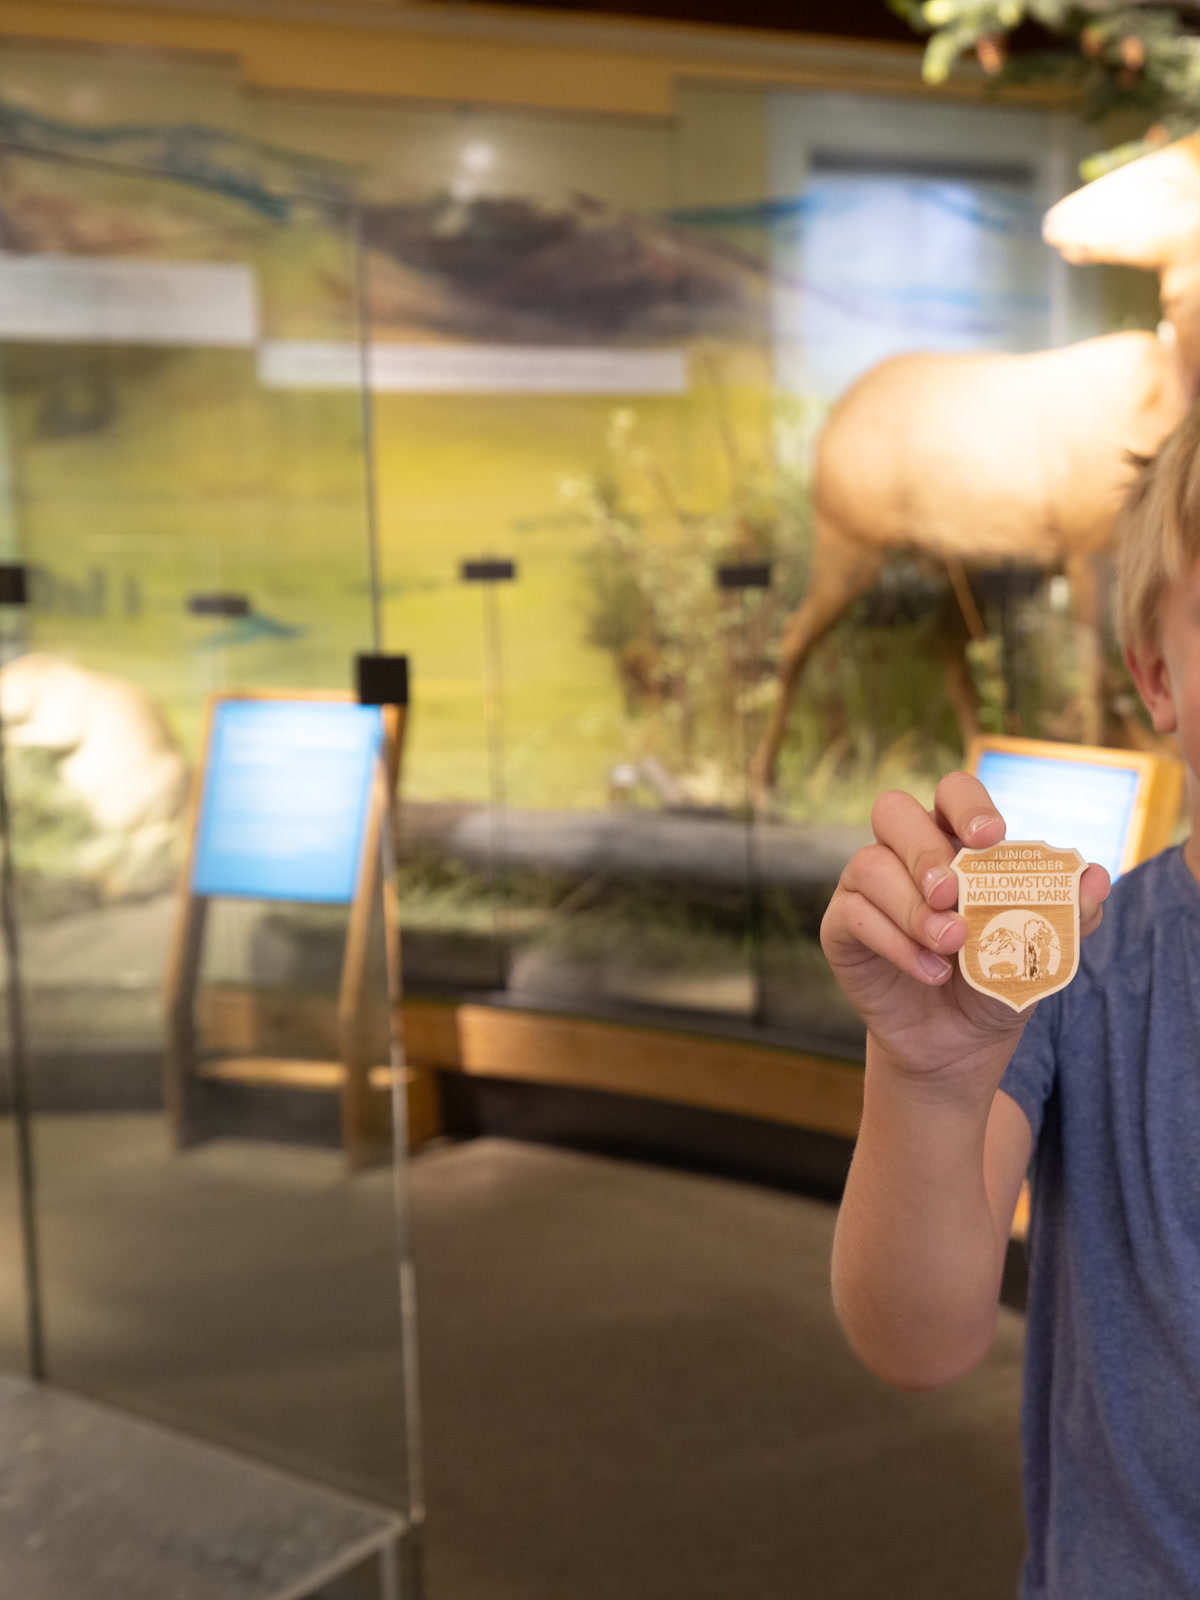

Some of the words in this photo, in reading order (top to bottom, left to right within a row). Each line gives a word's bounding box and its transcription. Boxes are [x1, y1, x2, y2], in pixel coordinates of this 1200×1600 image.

[993, 850, 1041, 860] JUNIOR
[971, 861, 1004, 871] PARK
[1008, 860, 1063, 870] RANGER
[966, 875, 1072, 888] YELLOWSTONE
[967, 890, 1034, 902] NATIONAL
[1037, 890, 1071, 902] PARK
